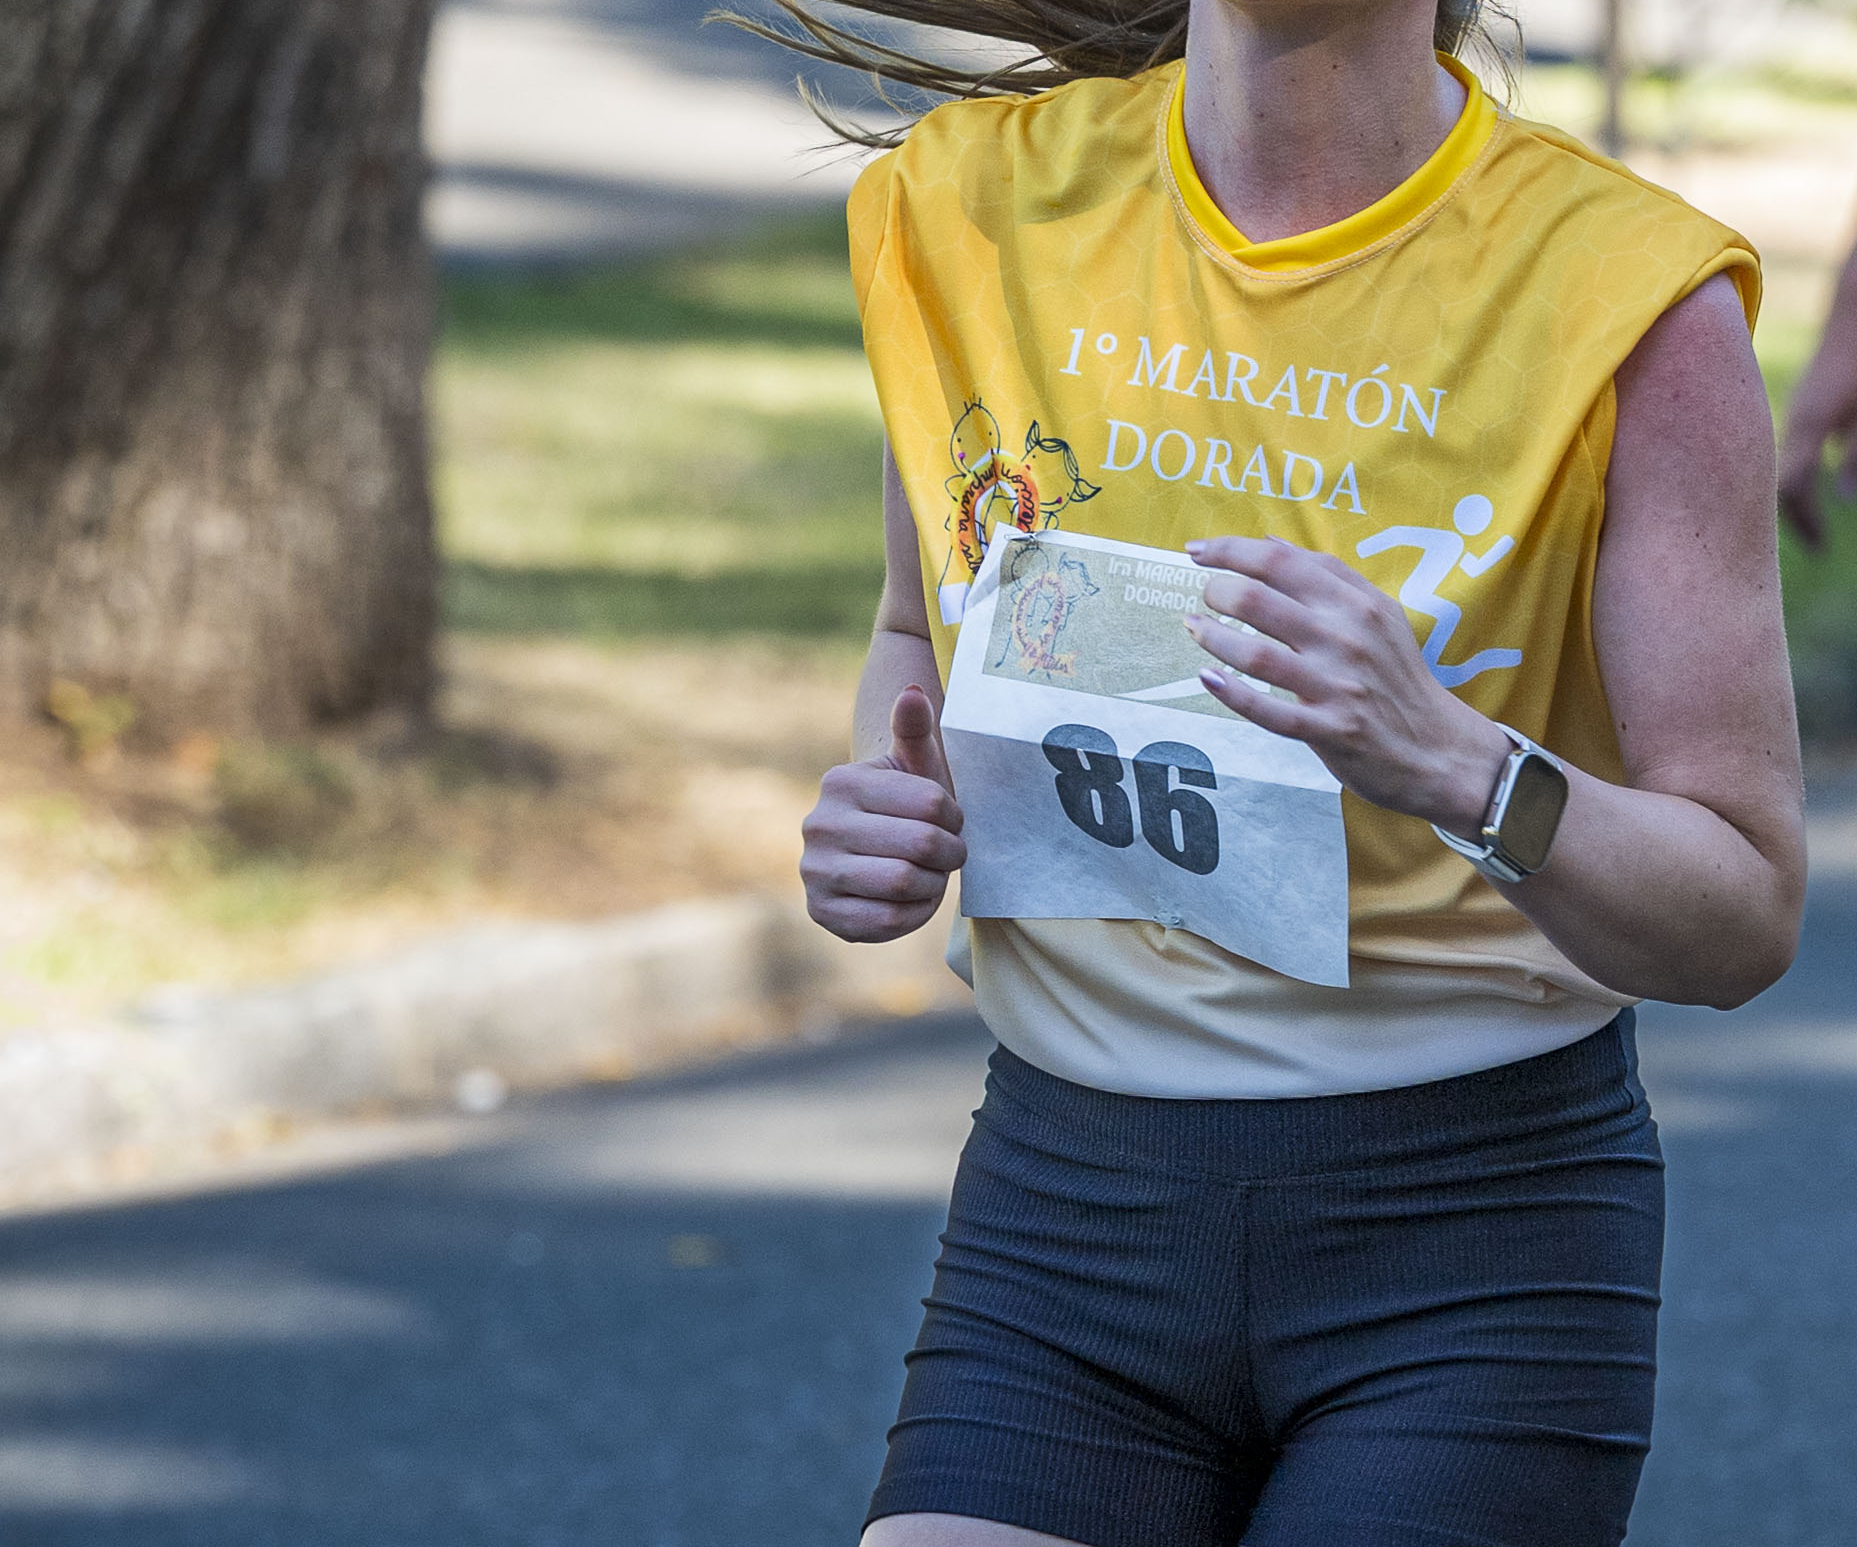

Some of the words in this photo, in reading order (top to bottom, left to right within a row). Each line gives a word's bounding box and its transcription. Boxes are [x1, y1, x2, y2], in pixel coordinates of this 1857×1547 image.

[1127, 336, 1448, 438] MARATÓN
[1100, 418, 1367, 515] DORADA
[1123, 583, 1199, 614] DORADA
[1134, 560, 1211, 590] MARATO
[1041, 723, 1220, 876] 86
